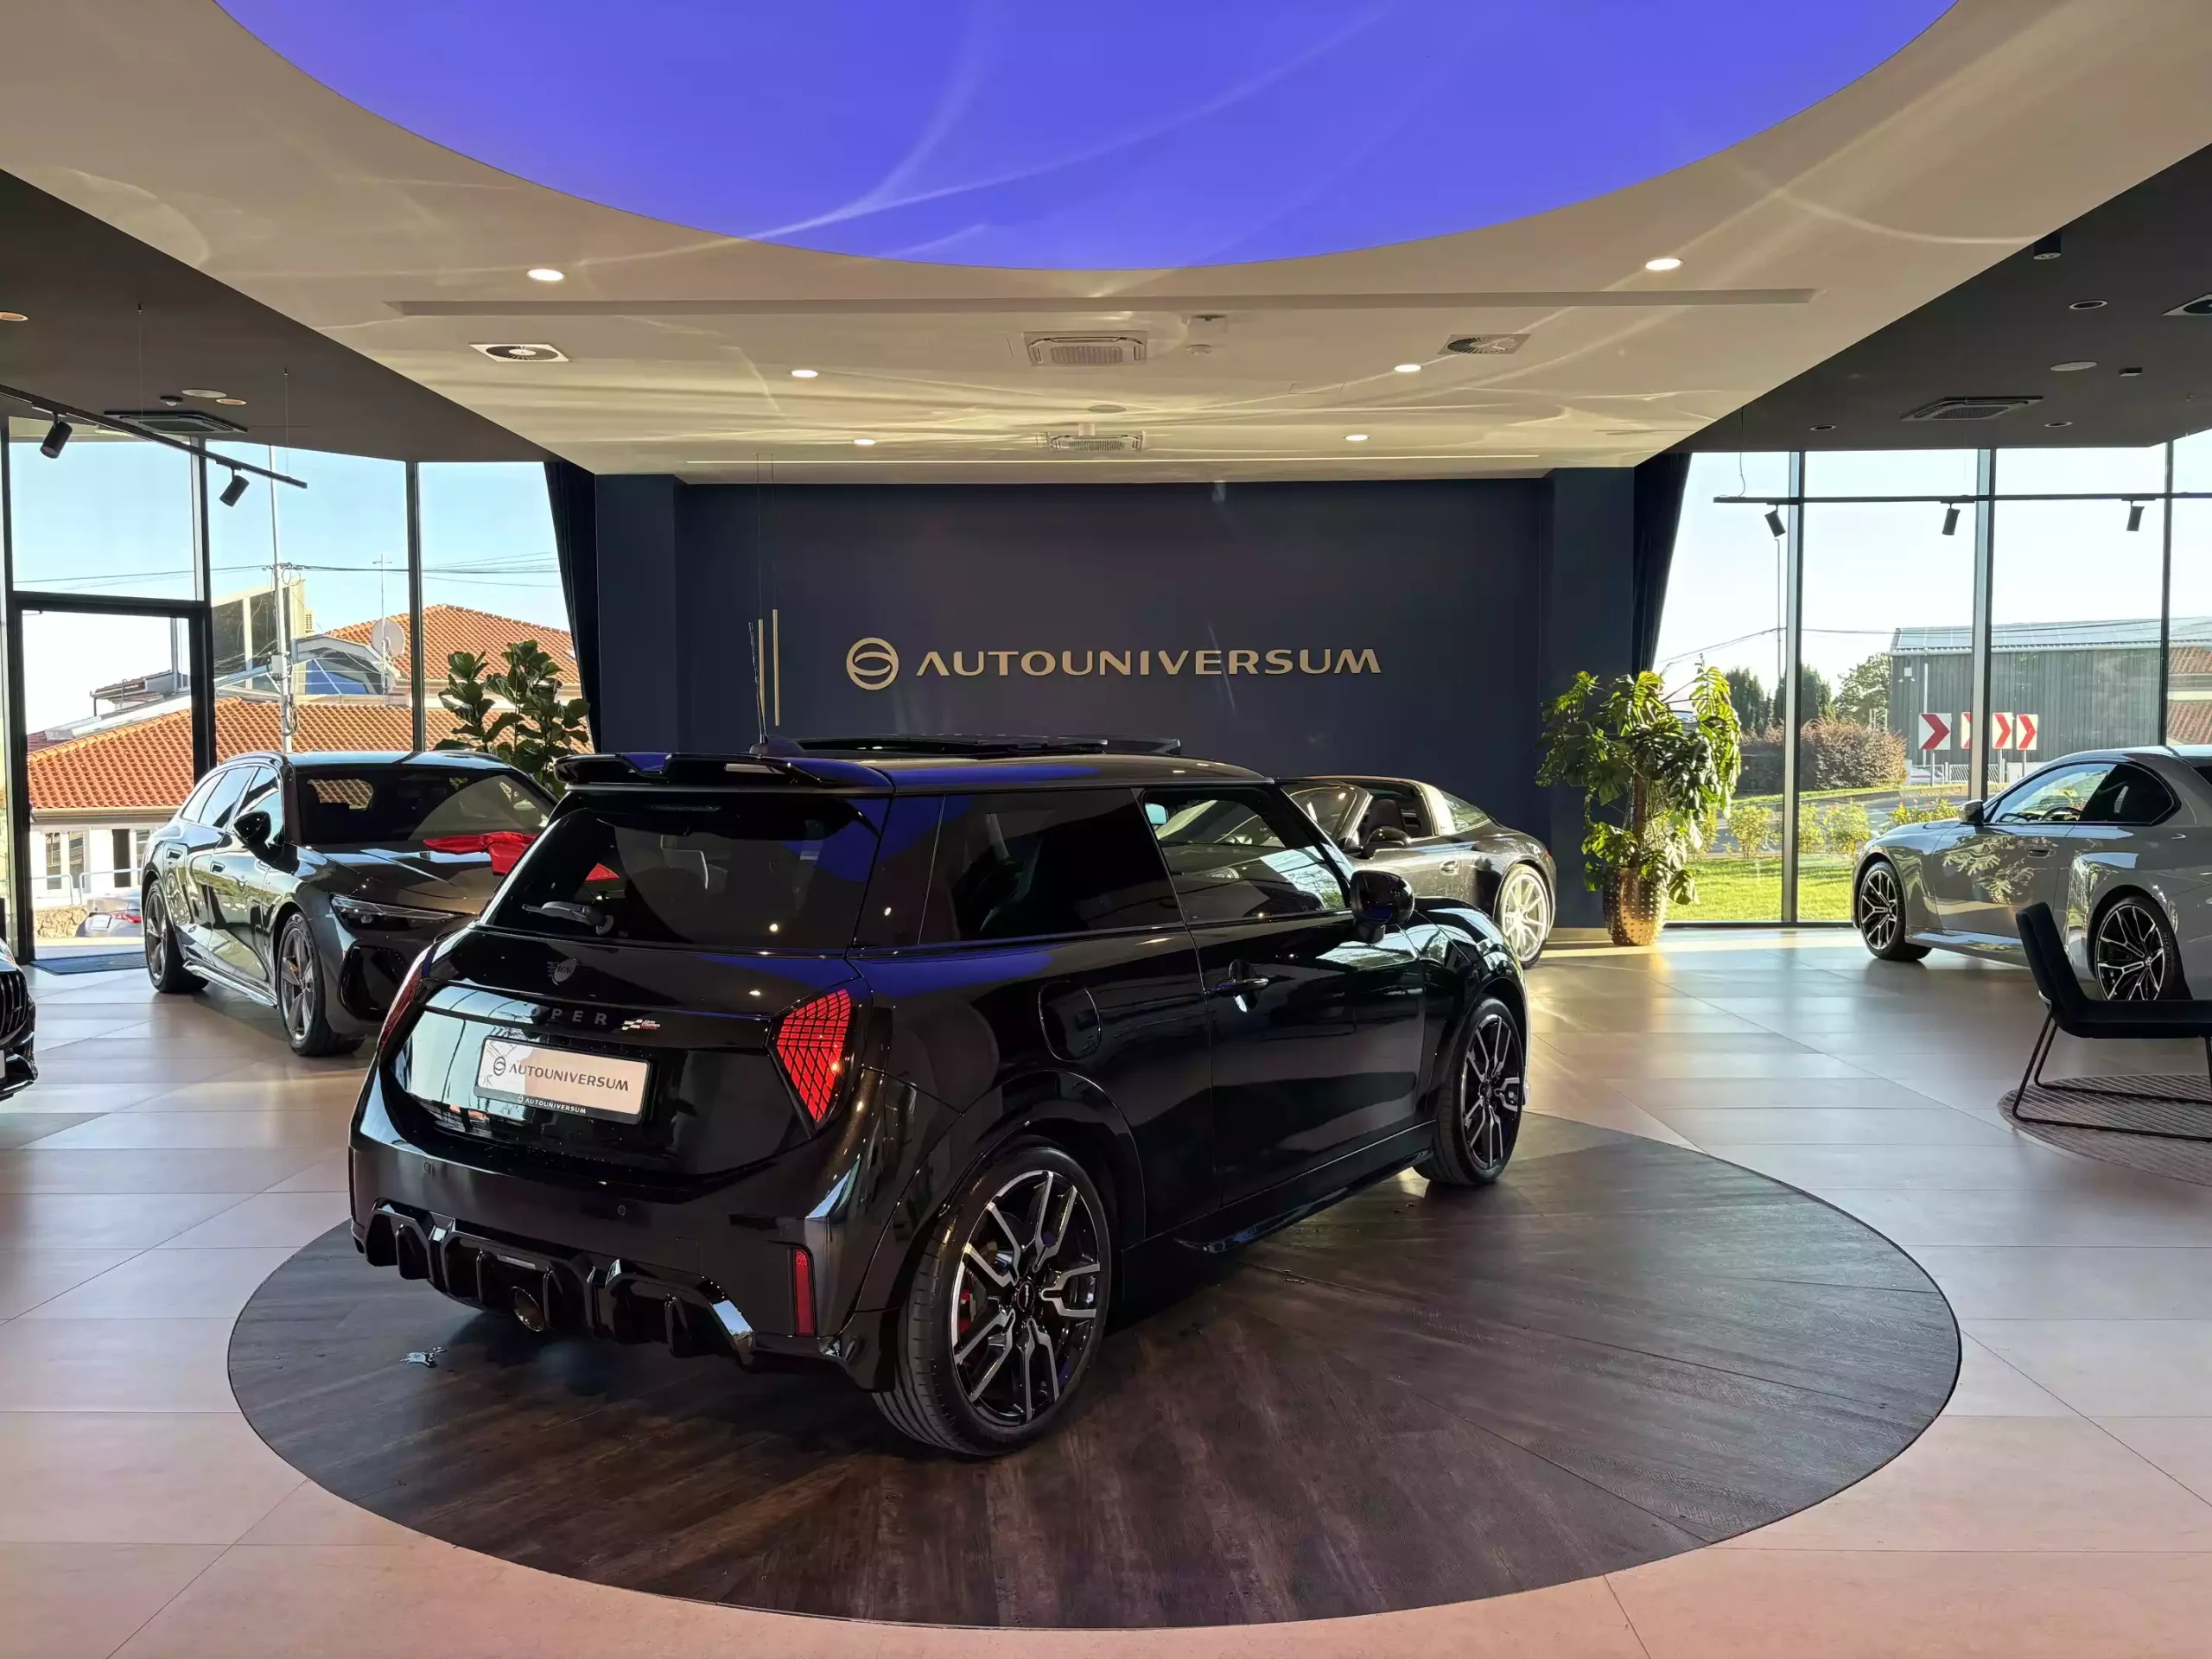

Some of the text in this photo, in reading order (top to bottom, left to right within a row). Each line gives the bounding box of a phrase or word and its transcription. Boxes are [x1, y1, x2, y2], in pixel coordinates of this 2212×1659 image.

[918, 648, 1380, 677] AUTOUNIVERSUM
[556, 965, 573, 974] MINI
[509, 1064, 629, 1091] AUTOUNIVERSUM
[525, 1098, 587, 1114] AUTOUNIVERSUM
